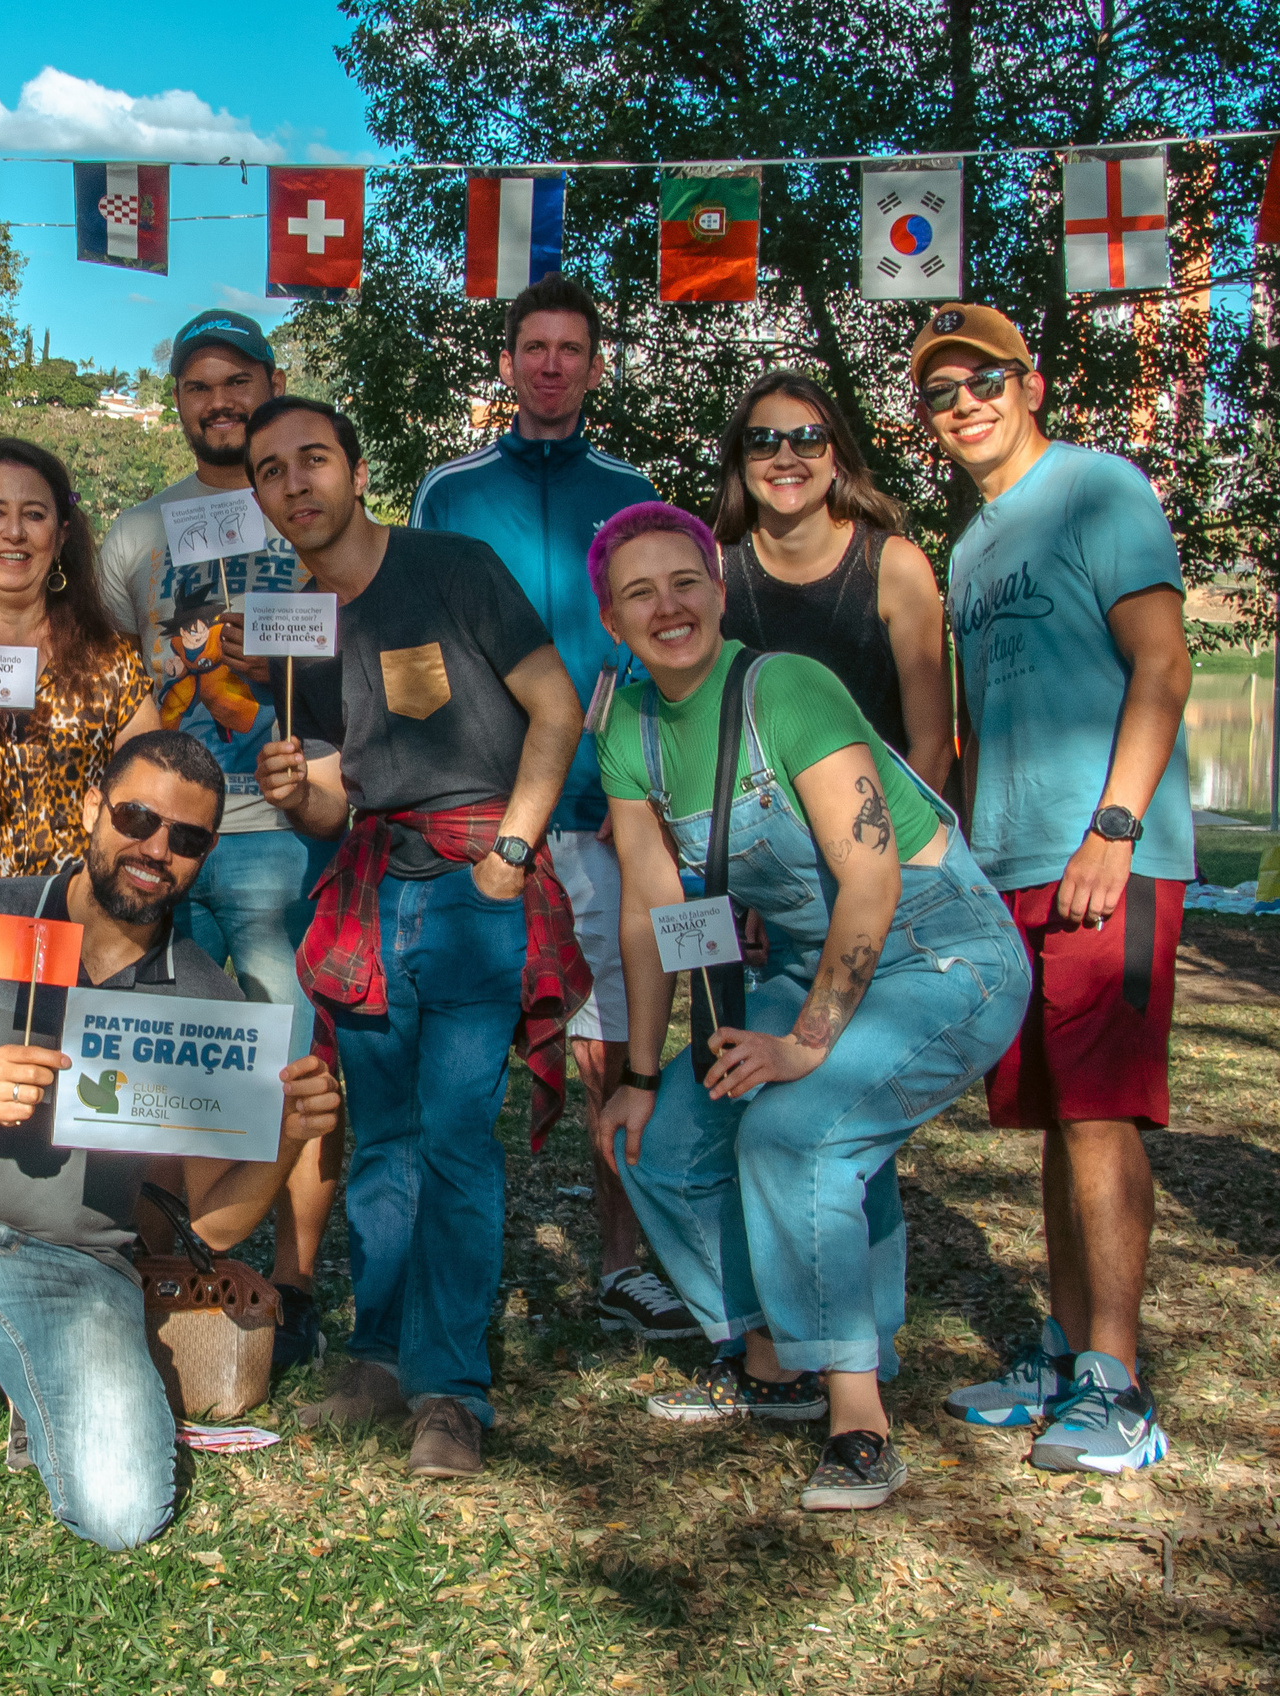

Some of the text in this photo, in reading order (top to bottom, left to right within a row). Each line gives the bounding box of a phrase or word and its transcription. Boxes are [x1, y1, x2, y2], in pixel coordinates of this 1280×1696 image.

[210, 499, 245, 509] Praticando
[275, 614, 290, 622] moi,
[252, 620, 323, 633] É tudo que sei
[259, 632, 316, 642] de Francês
[658, 907, 720, 924] Mãe, tô falando
[660, 918, 707, 935] ALEMÃO!
[84, 1014, 259, 1043] PRATIQUE IDIOMAS
[81, 1032, 257, 1075] DE GRAÇA!
[132, 1082, 168, 1094] CLUBE
[132, 1092, 221, 1113] POLIGLOTA
[130, 1107, 170, 1120] BRASIL
